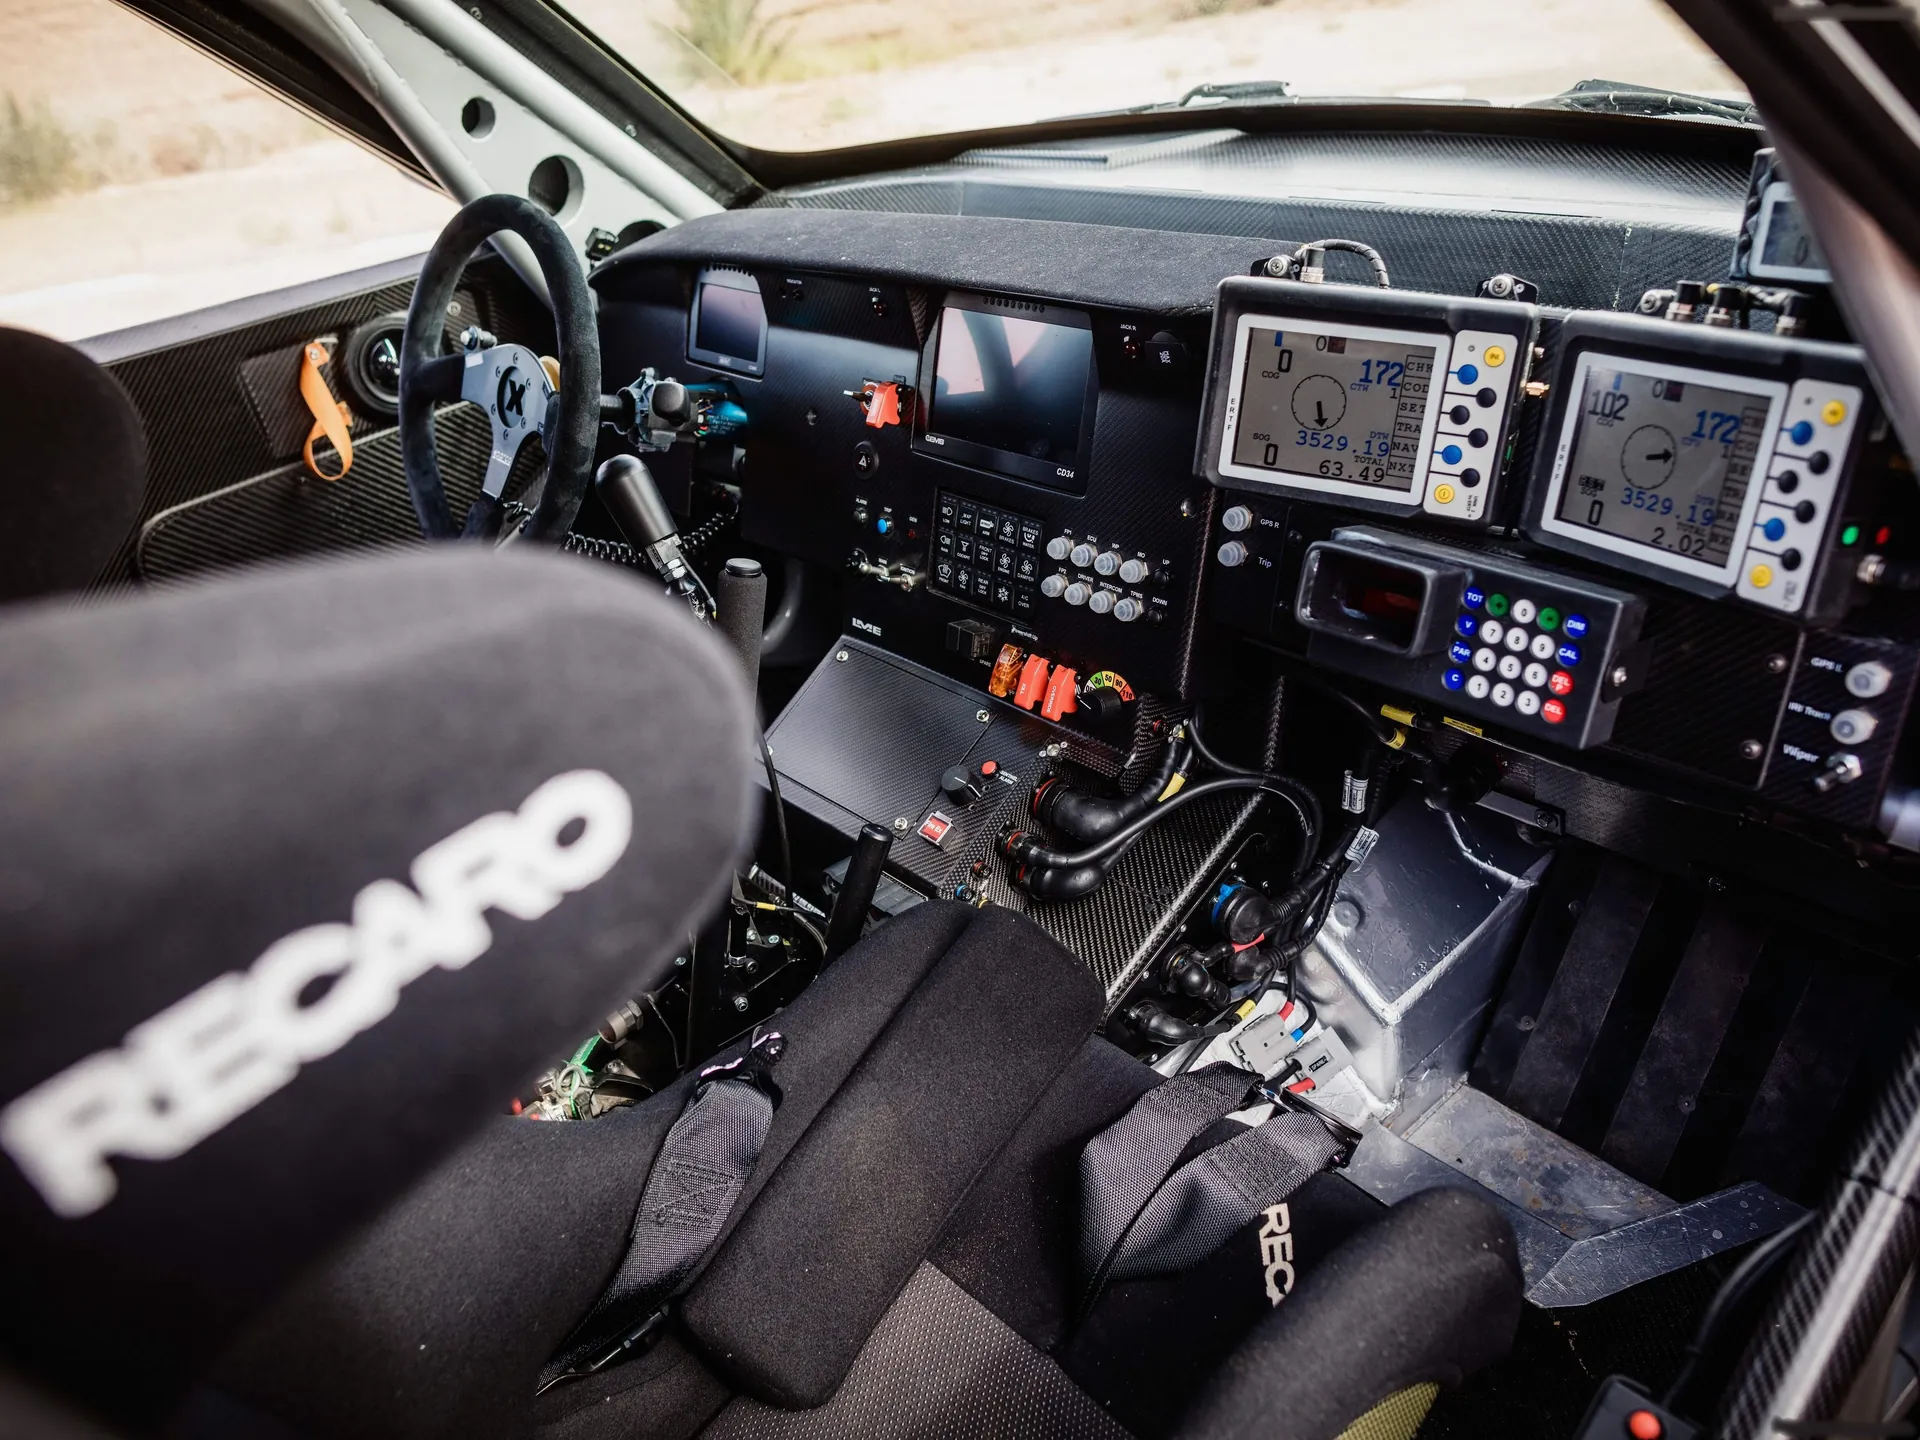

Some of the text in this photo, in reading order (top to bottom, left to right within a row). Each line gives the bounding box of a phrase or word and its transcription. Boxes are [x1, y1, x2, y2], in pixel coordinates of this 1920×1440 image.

[1316, 335, 1327, 351] 0
[1278, 349, 1293, 373] 0
[1407, 362, 1434, 373] CHK
[1262, 371, 1280, 379] COG
[1359, 359, 1404, 388] 172
[1350, 383, 1369, 392] CTW
[1404, 382, 1429, 394] COD
[1390, 388, 1398, 399] 1
[1400, 403, 1426, 413] SET
[1588, 389, 1629, 421] 102
[1227, 398, 1236, 430] ERTF
[1396, 422, 1421, 434] TRA
[1692, 409, 1741, 444] 172
[1253, 432, 1271, 441] SOG
[1370, 431, 1389, 440] DTW
[1296, 430, 1389, 457] 3529.19
[1392, 442, 1419, 453] NAV
[1264, 443, 1279, 466] 0
[1354, 456, 1384, 466] TOTAL
[1319, 460, 1385, 482] 63.49
[1388, 461, 1415, 473] NXT
[1056, 467, 1075, 478] CD34
[1620, 487, 1716, 526] 3529.19
[1588, 500, 1604, 526] 0
[1260, 518, 1274, 526] GPS
[1022, 526, 1039, 536] BRAKES
[999, 534, 1015, 544] BRAKES
[1087, 535, 1097, 543] ECU
[1651, 526, 1705, 557] 2.02
[979, 544, 993, 553] FRONT
[1258, 556, 1272, 568] Trip
[1017, 572, 1035, 582] DAMPER
[1078, 573, 1094, 583] DRIVER
[1100, 582, 1123, 593] INTERCOM
[1152, 597, 1168, 606] DOWN
[1467, 592, 1484, 602] TOT
[1018, 600, 1030, 608] OVER
[1521, 608, 1528, 617] 0
[1567, 619, 1586, 631] DIM
[1490, 628, 1496, 637] 7
[1514, 636, 1520, 645] 8
[1453, 645, 1472, 656] PAR
[1539, 644, 1546, 652] 9
[1558, 647, 1578, 660] CAL
[1484, 656, 1489, 664] 4
[1811, 656, 1835, 670] GPS
[1507, 664, 1514, 672] 5
[1104, 674, 1112, 682] 50
[1452, 674, 1460, 682] C
[1532, 671, 1538, 680] 6
[1552, 674, 1570, 687] DEL
[1094, 677, 1102, 686] 30
[1115, 680, 1122, 688] 90
[1477, 683, 1482, 691] 1
[1046, 685, 1057, 713] OVERRIDE
[1122, 690, 1133, 700] 110
[1500, 690, 1507, 699] 2
[1525, 698, 1531, 706] 3
[1544, 702, 1563, 715] DEL
[0, 768, 633, 1219] RECARO
[1259, 1203, 1295, 1307] REC
